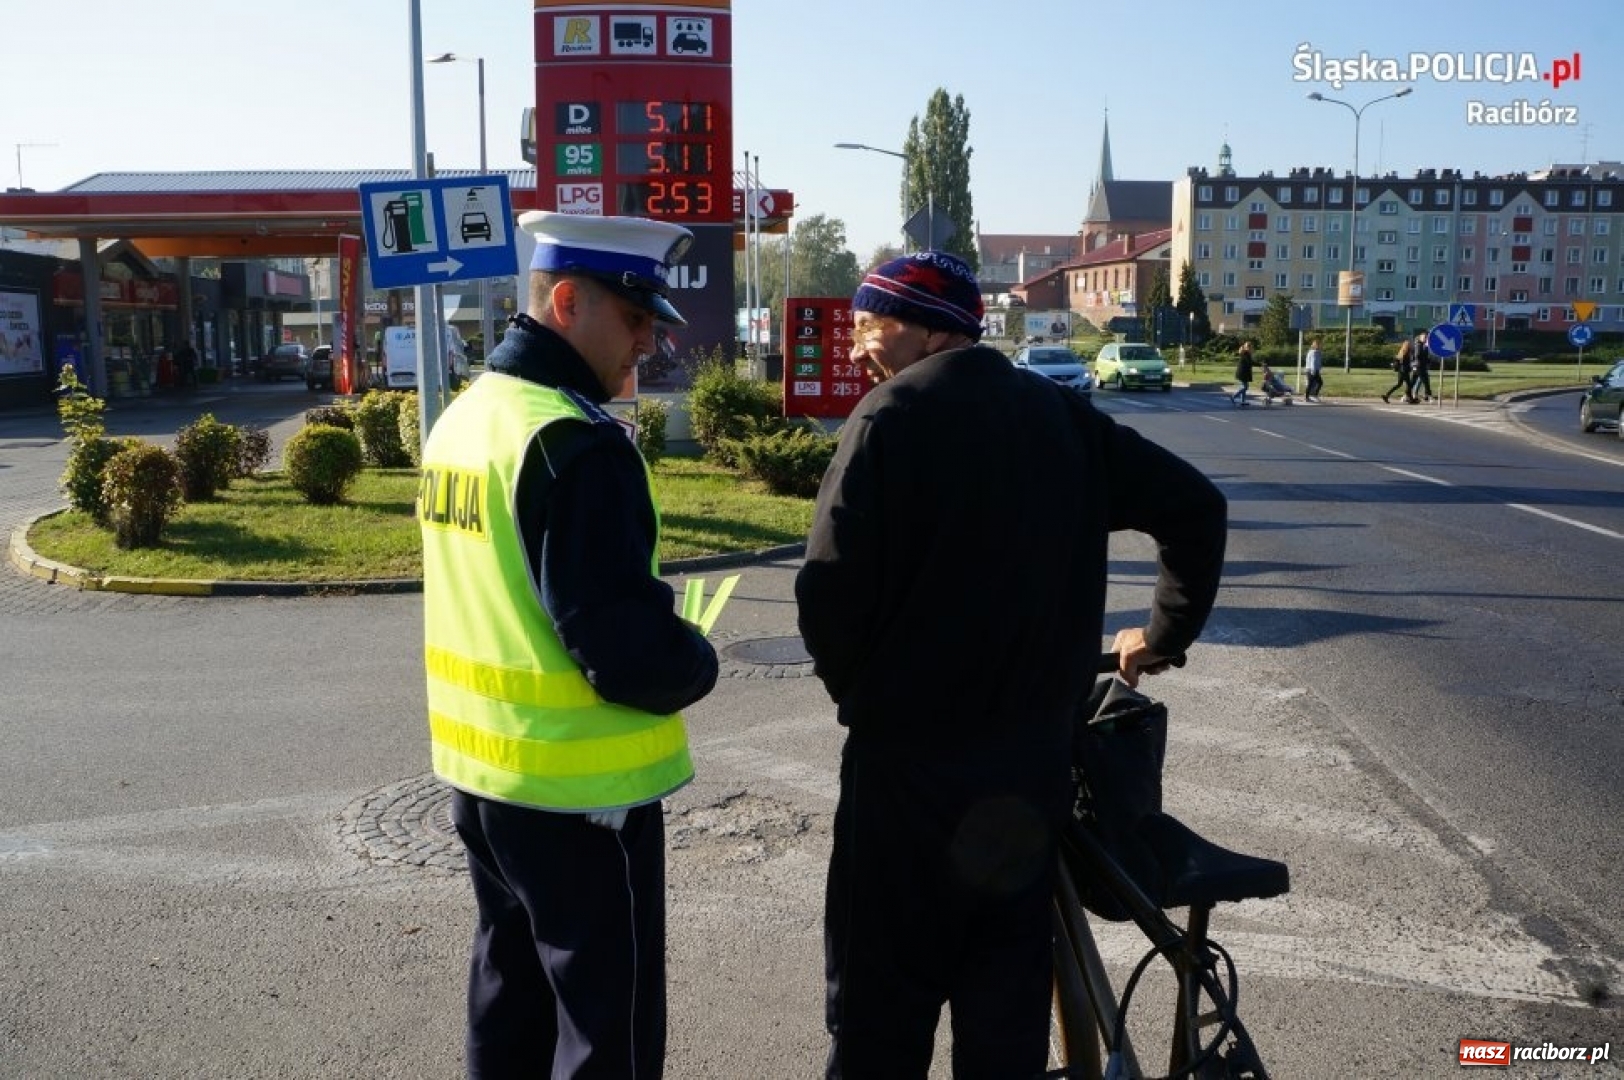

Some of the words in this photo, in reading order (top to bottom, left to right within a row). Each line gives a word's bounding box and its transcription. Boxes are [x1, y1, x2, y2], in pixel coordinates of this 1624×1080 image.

[568, 103, 590, 125] D
[646, 101, 713, 133] 5.11
[566, 126, 593, 135] miles
[565, 144, 594, 165] 95
[647, 141, 713, 174] 5.11
[566, 166, 592, 175] miles
[559, 187, 600, 204] LPG
[647, 182, 713, 214] 2.53
[832, 364, 862, 378] 5.26
[420, 469, 483, 533] OLICJA
